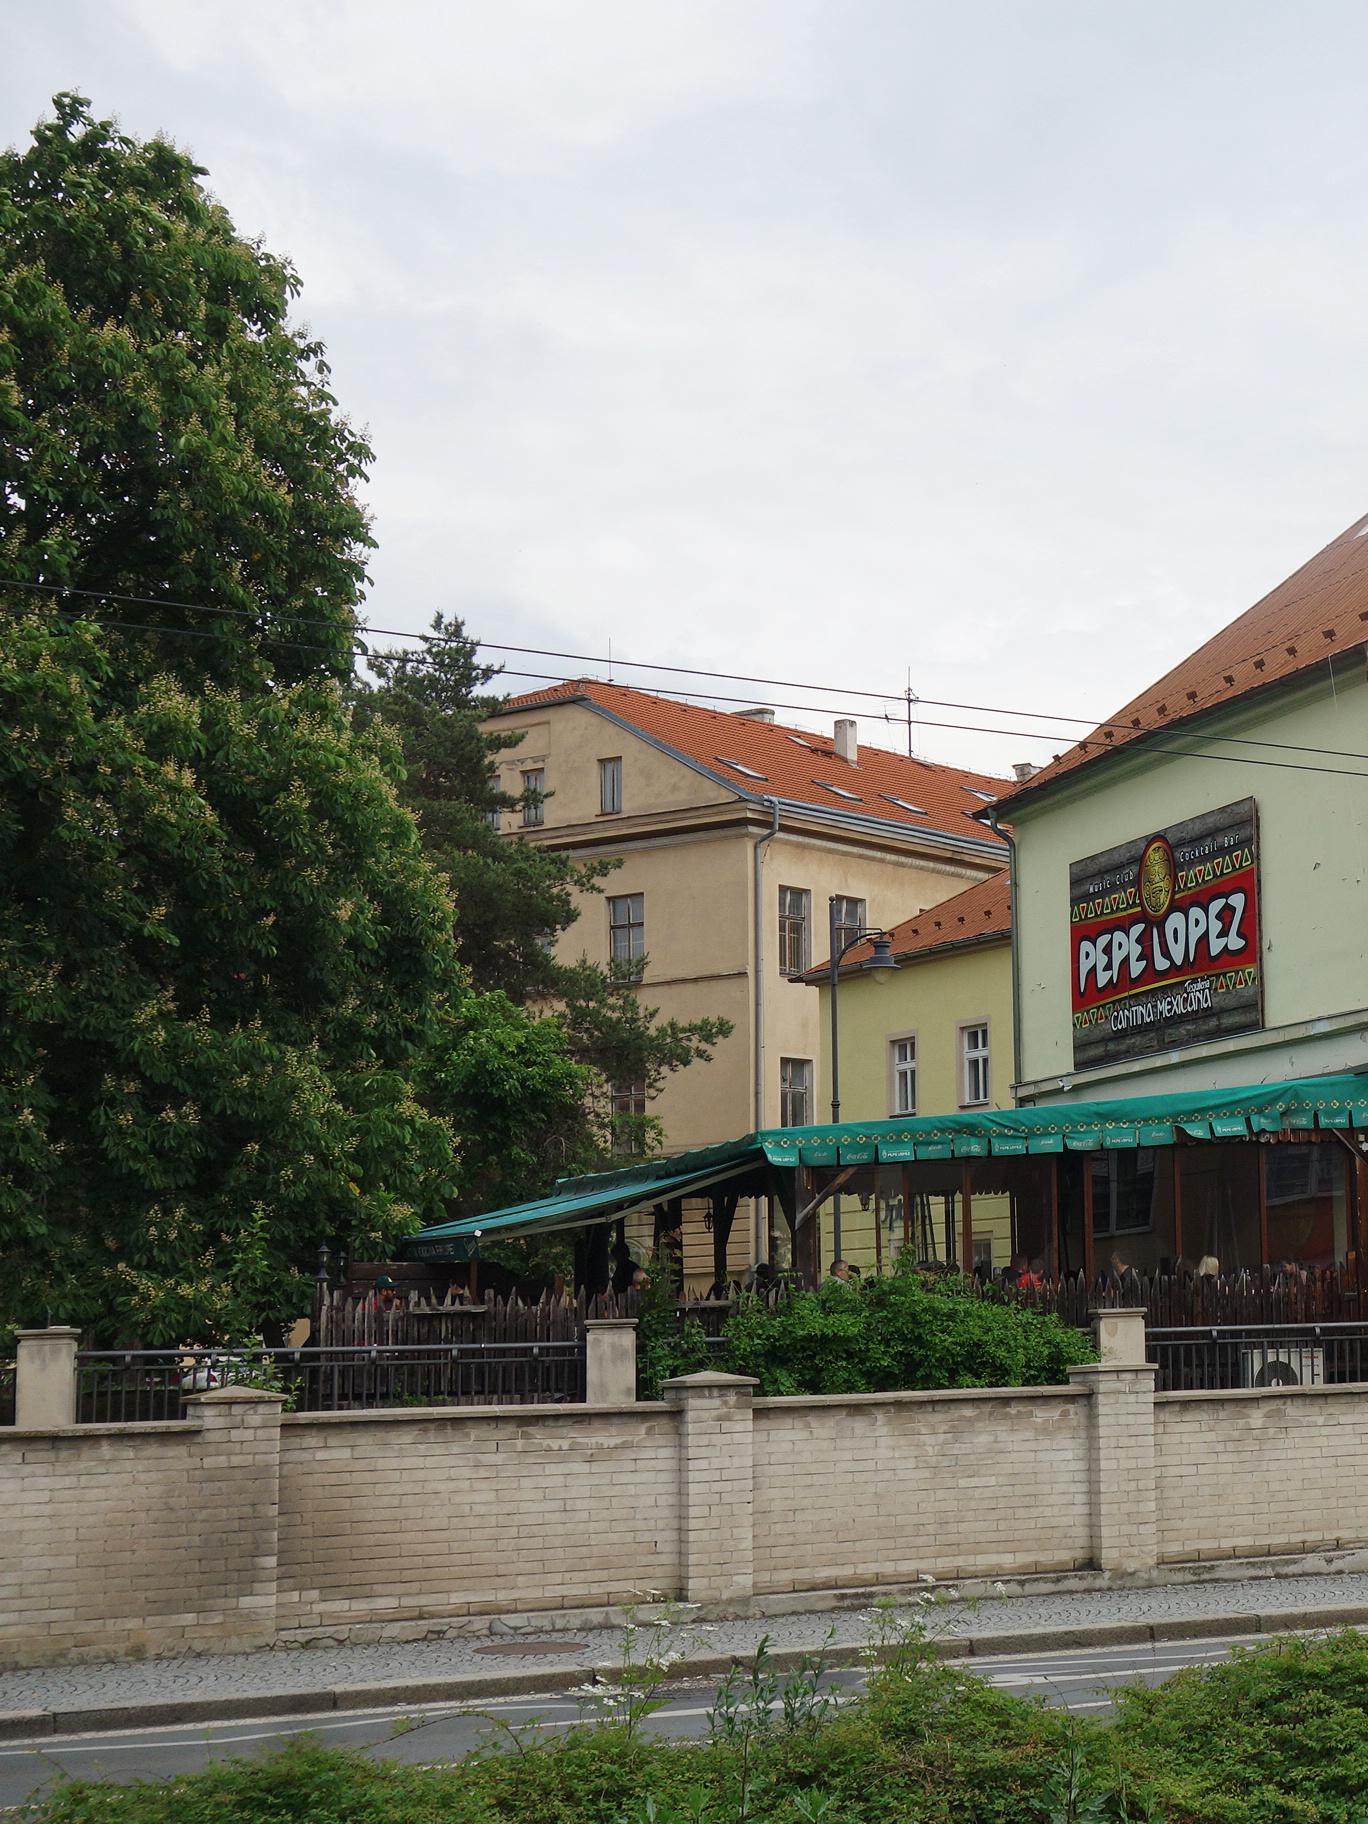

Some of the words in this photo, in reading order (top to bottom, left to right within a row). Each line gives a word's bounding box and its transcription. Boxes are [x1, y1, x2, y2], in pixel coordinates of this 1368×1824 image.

[1179, 840, 1218, 862] Cocktail
[1224, 834, 1240, 846] Bar
[1088, 876, 1111, 894] Music
[1115, 870, 1135, 886] Club
[1079, 923, 1147, 993] PEPE
[1152, 892, 1246, 971] LOPEZ
[1111, 1002, 1154, 1031] CANTINA
[1157, 988, 1212, 1020] MEXICANA
